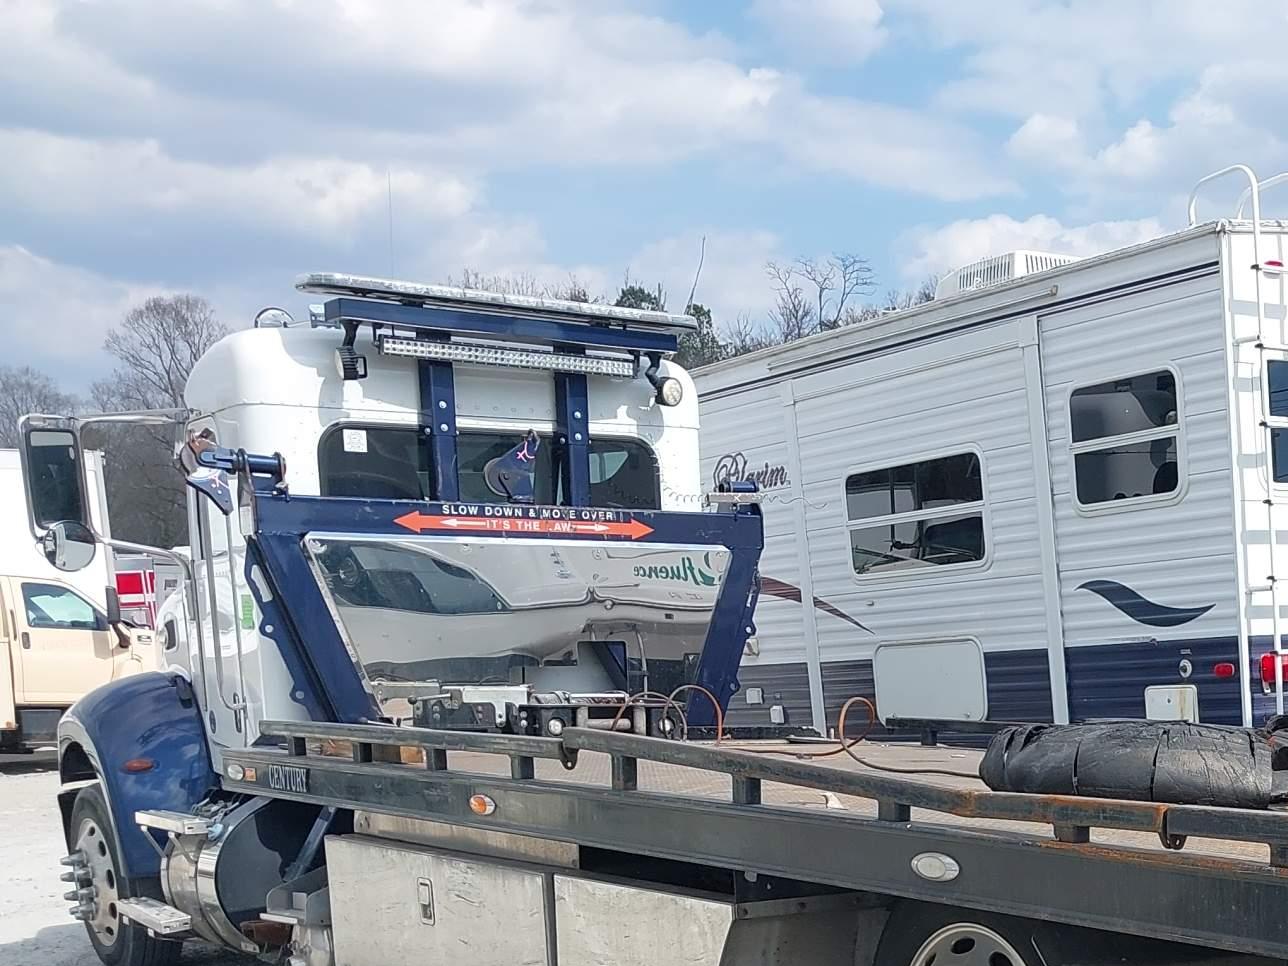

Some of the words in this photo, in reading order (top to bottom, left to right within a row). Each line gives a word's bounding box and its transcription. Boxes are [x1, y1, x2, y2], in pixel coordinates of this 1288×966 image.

[442, 504, 479, 515] SLOW
[484, 506, 523, 517] DOWN
[528, 508, 536, 518] &
[581, 510, 613, 521] OVER
[486, 519, 511, 530] IT'S
[516, 520, 540, 531] THE
[548, 521, 571, 532] AW
[268, 764, 307, 793] CENTURY
